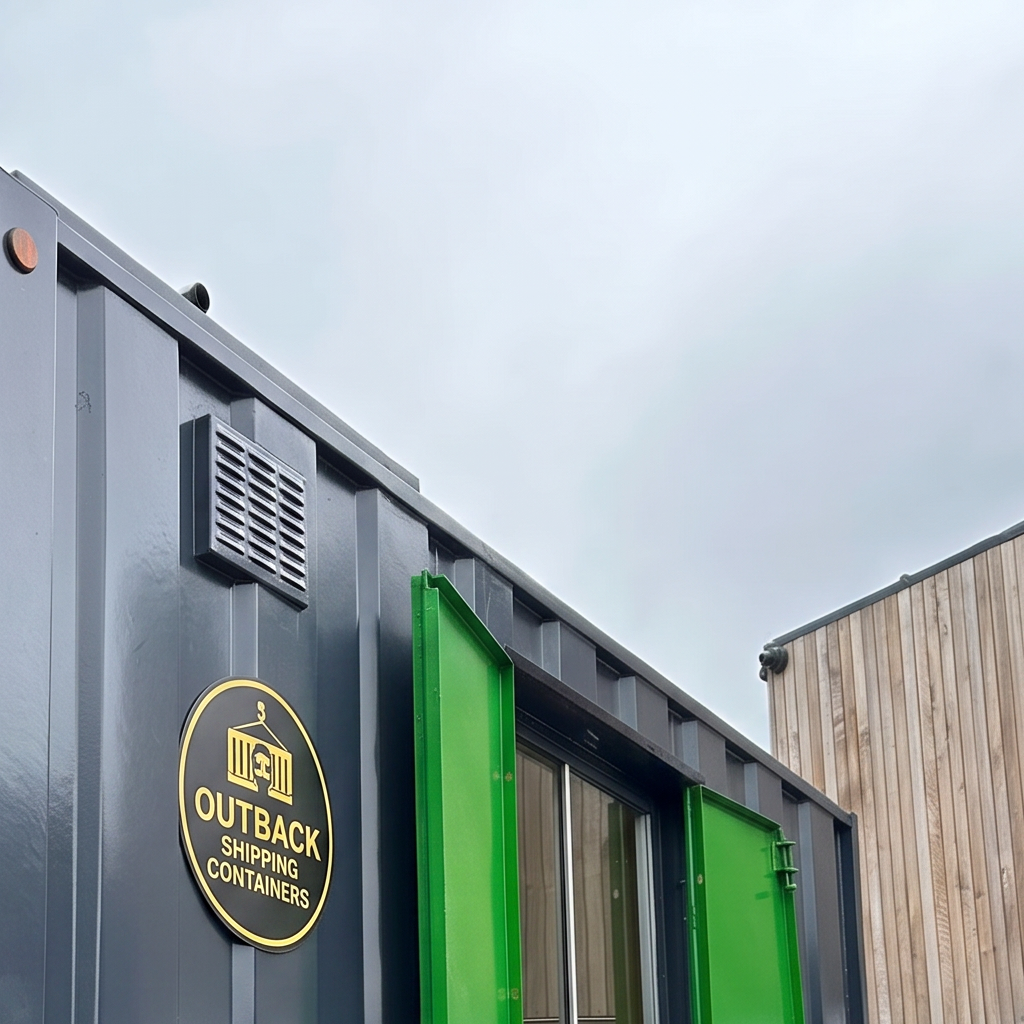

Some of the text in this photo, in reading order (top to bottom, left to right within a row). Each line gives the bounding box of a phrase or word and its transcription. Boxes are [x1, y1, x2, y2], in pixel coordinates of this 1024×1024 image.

[194, 786, 322, 861] OUTBACK
[207, 857, 310, 910] CONTAINERS
[221, 835, 298, 880] SHIPPING
